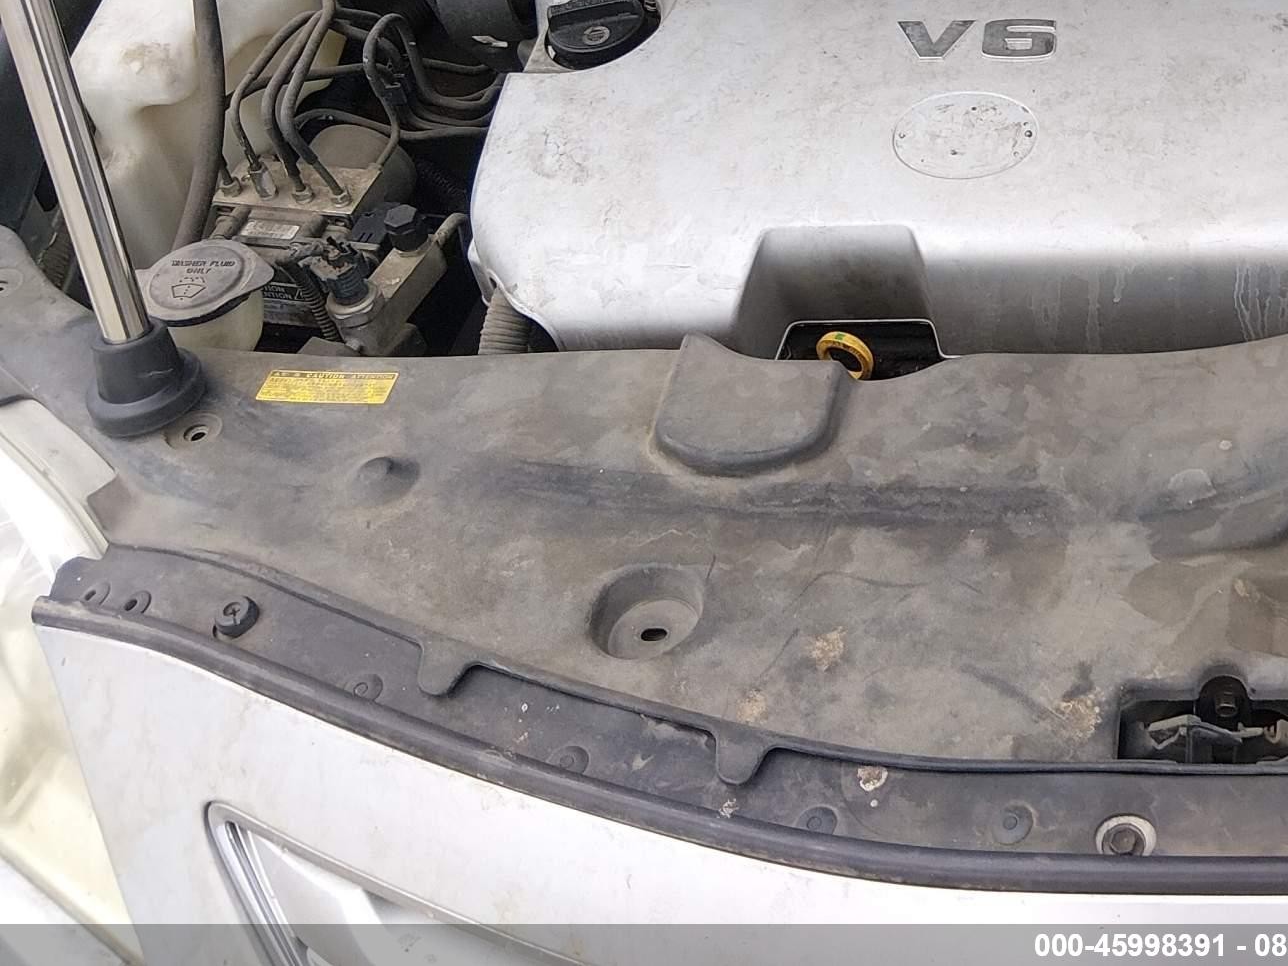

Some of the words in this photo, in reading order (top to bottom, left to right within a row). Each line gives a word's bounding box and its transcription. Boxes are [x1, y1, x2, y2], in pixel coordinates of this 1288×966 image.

[897, 18, 1057, 60] V6
[186, 267, 212, 275] ONLY
[306, 372, 345, 380] CAUTION
